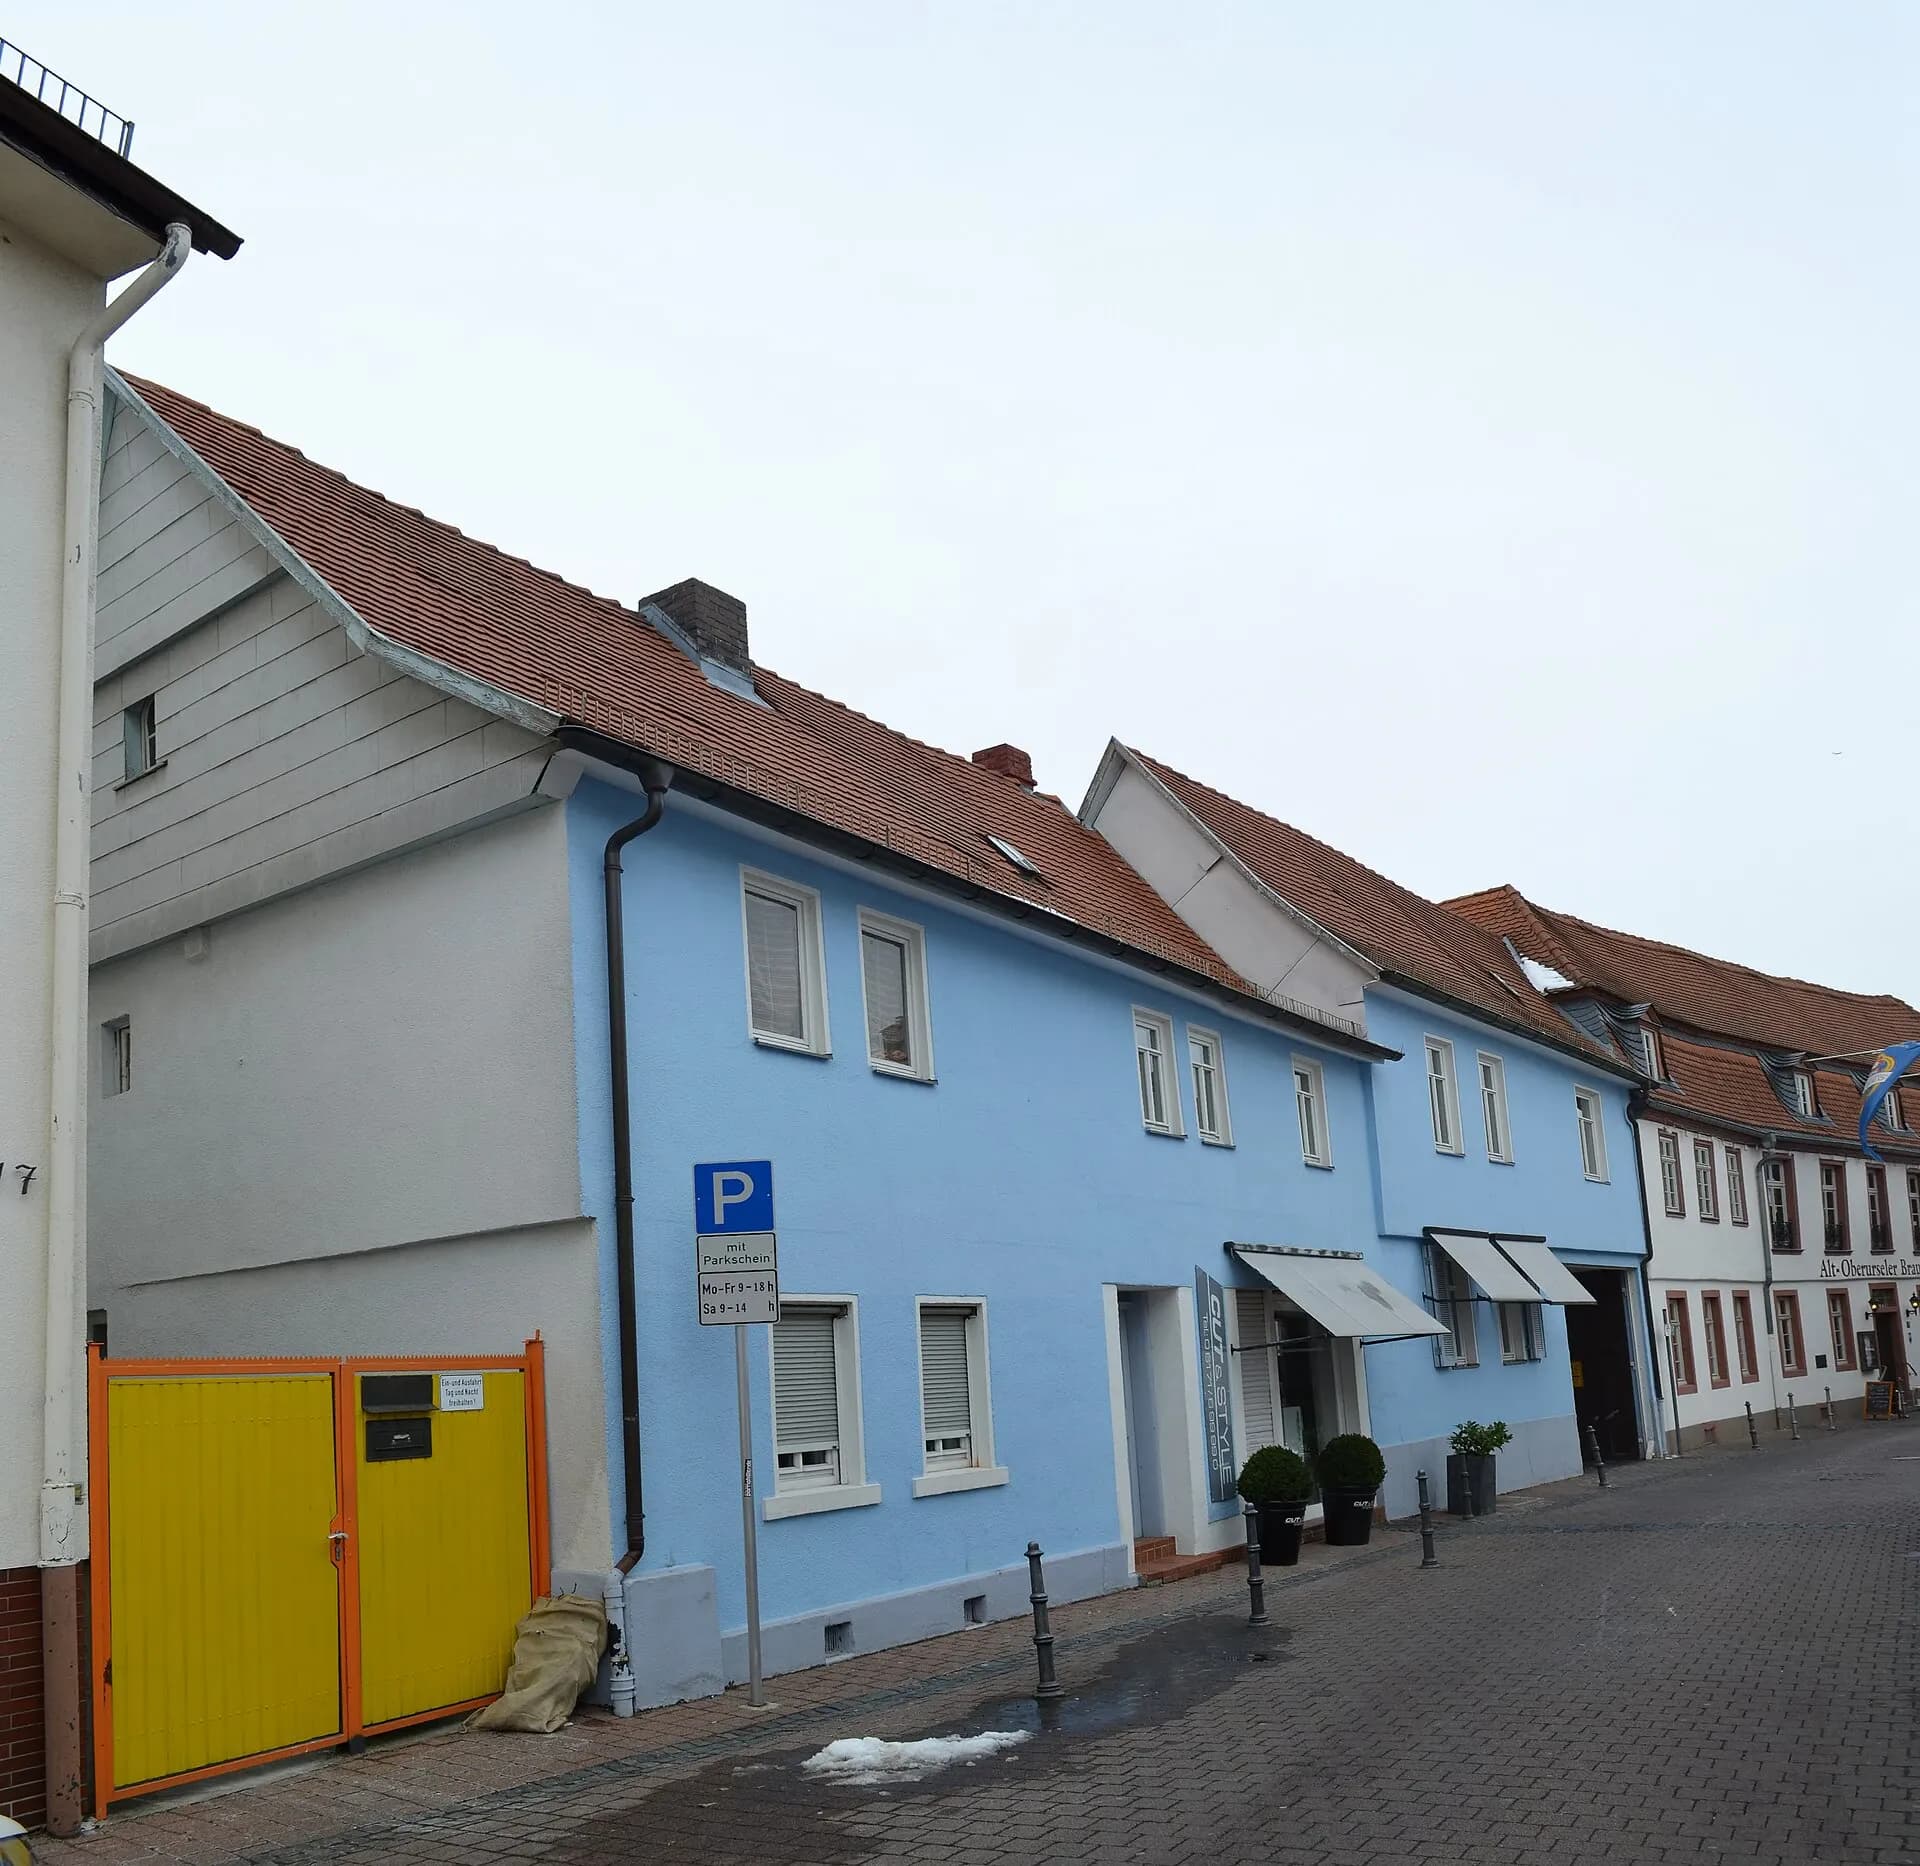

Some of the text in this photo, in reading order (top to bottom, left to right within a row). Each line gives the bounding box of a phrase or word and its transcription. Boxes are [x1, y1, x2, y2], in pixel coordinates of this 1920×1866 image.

[712, 1171, 755, 1225] P
[726, 1242, 746, 1253] mit
[703, 1253, 771, 1266] Parkschein
[702, 1282, 736, 1295] Mo-Fr
[703, 1303, 716, 1315] Sa
[768, 1300, 775, 1312] h
